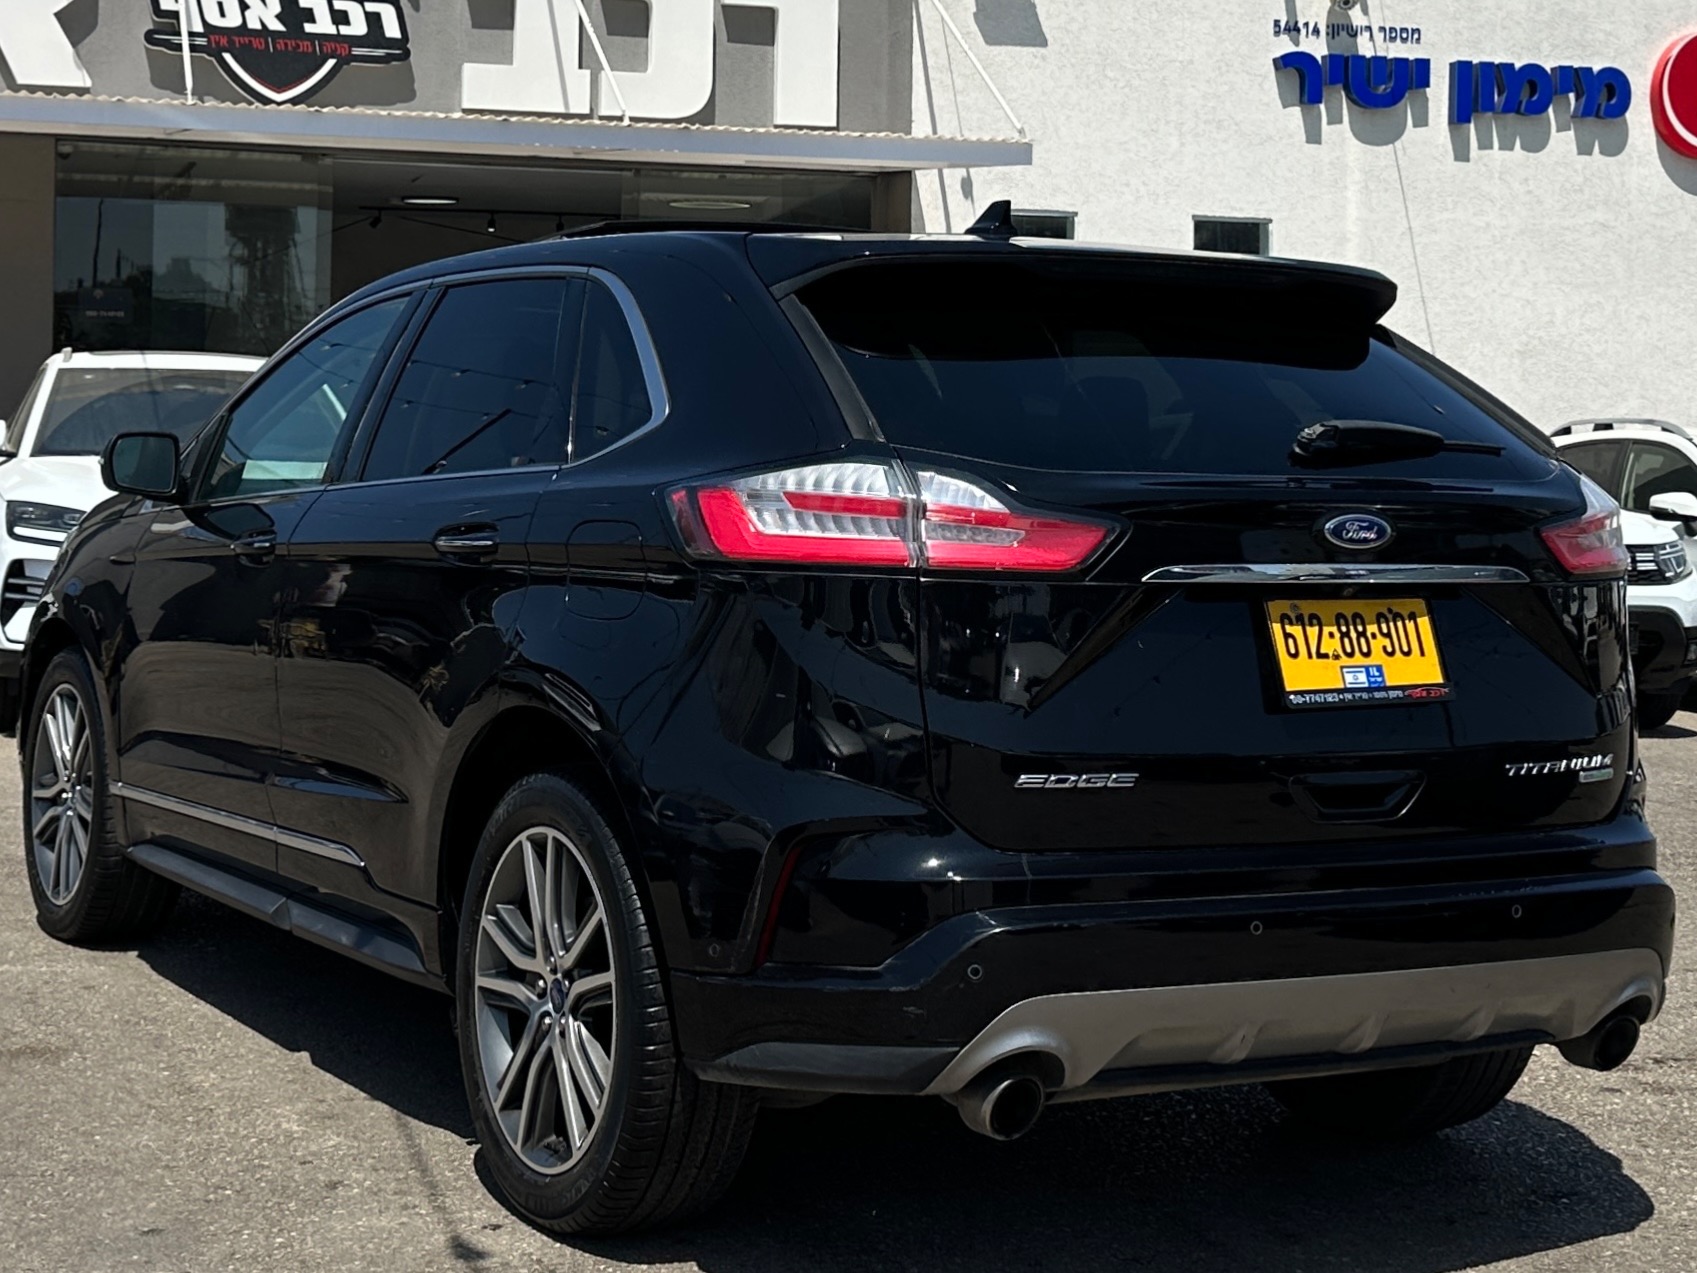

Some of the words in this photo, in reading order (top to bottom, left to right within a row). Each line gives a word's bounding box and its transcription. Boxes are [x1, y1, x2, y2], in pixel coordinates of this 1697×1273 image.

[299, 0, 402, 39] רכב
[1273, 19, 1321, 39] 54414
[208, 34, 229, 49] אין
[232, 36, 266, 49] טרייד
[1377, 25, 1421, 44] מספר
[276, 38, 313, 54] מכירה
[323, 41, 350, 57] קניה
[1273, 51, 1430, 109] ישיר
[1449, 60, 1632, 124] מימון
[1342, 520, 1378, 540] Ford
[1505, 753, 1614, 776] TITANIUM
[1014, 773, 1139, 788] EDGE
